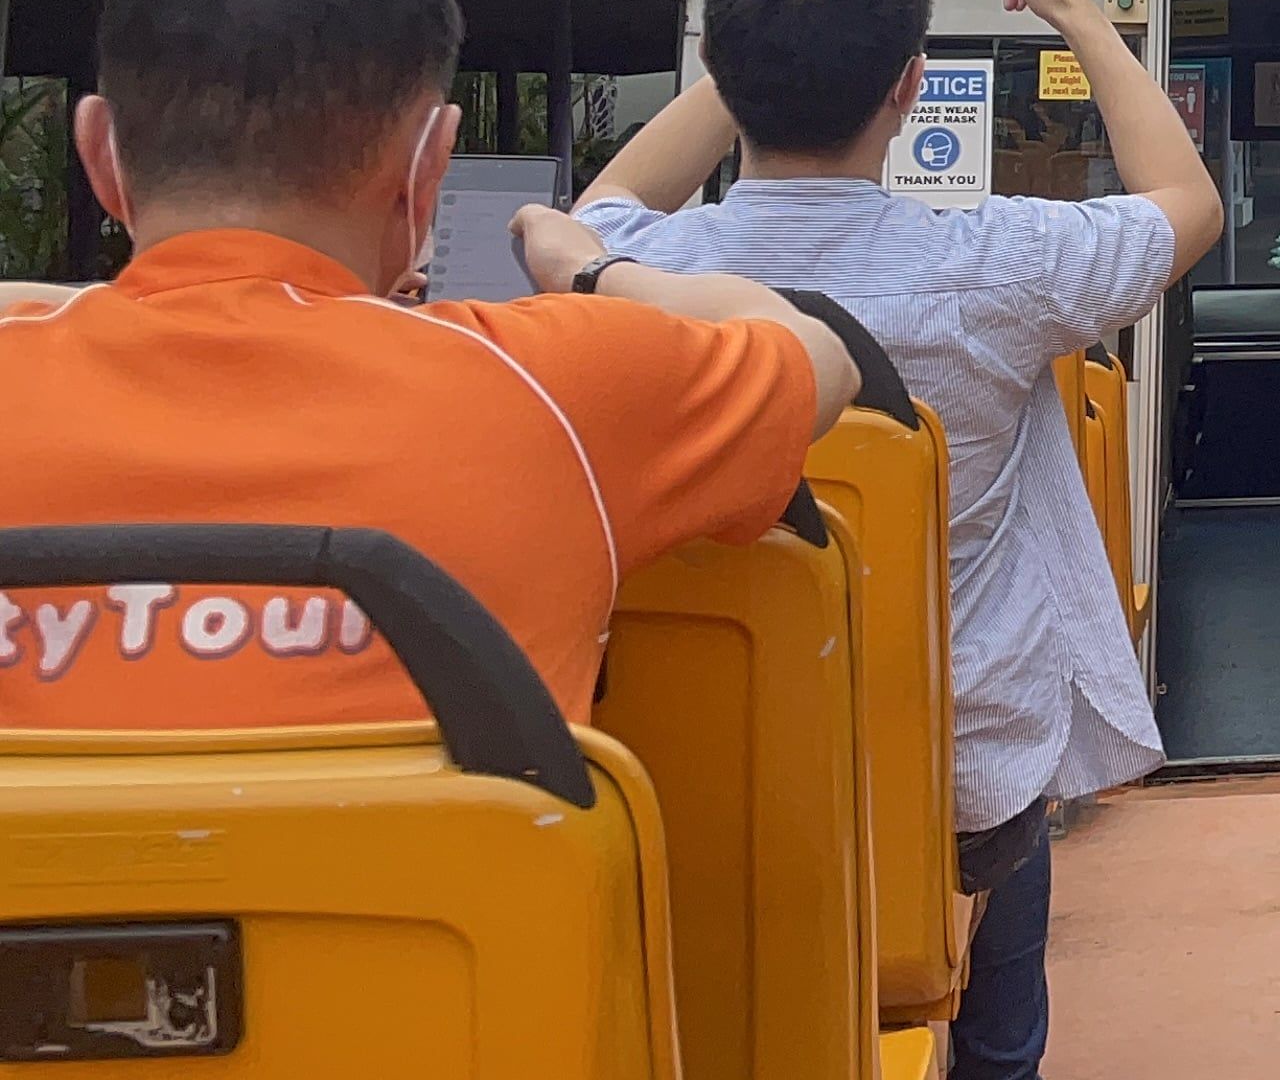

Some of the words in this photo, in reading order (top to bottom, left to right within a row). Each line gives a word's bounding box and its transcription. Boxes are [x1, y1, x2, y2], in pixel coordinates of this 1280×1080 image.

[919, 76, 983, 95] OTICE
[945, 106, 978, 114] WEAR
[911, 115, 940, 123] FACE
[943, 115, 977, 123] MASK
[895, 175, 943, 185] THANK
[947, 175, 976, 185] YOU
